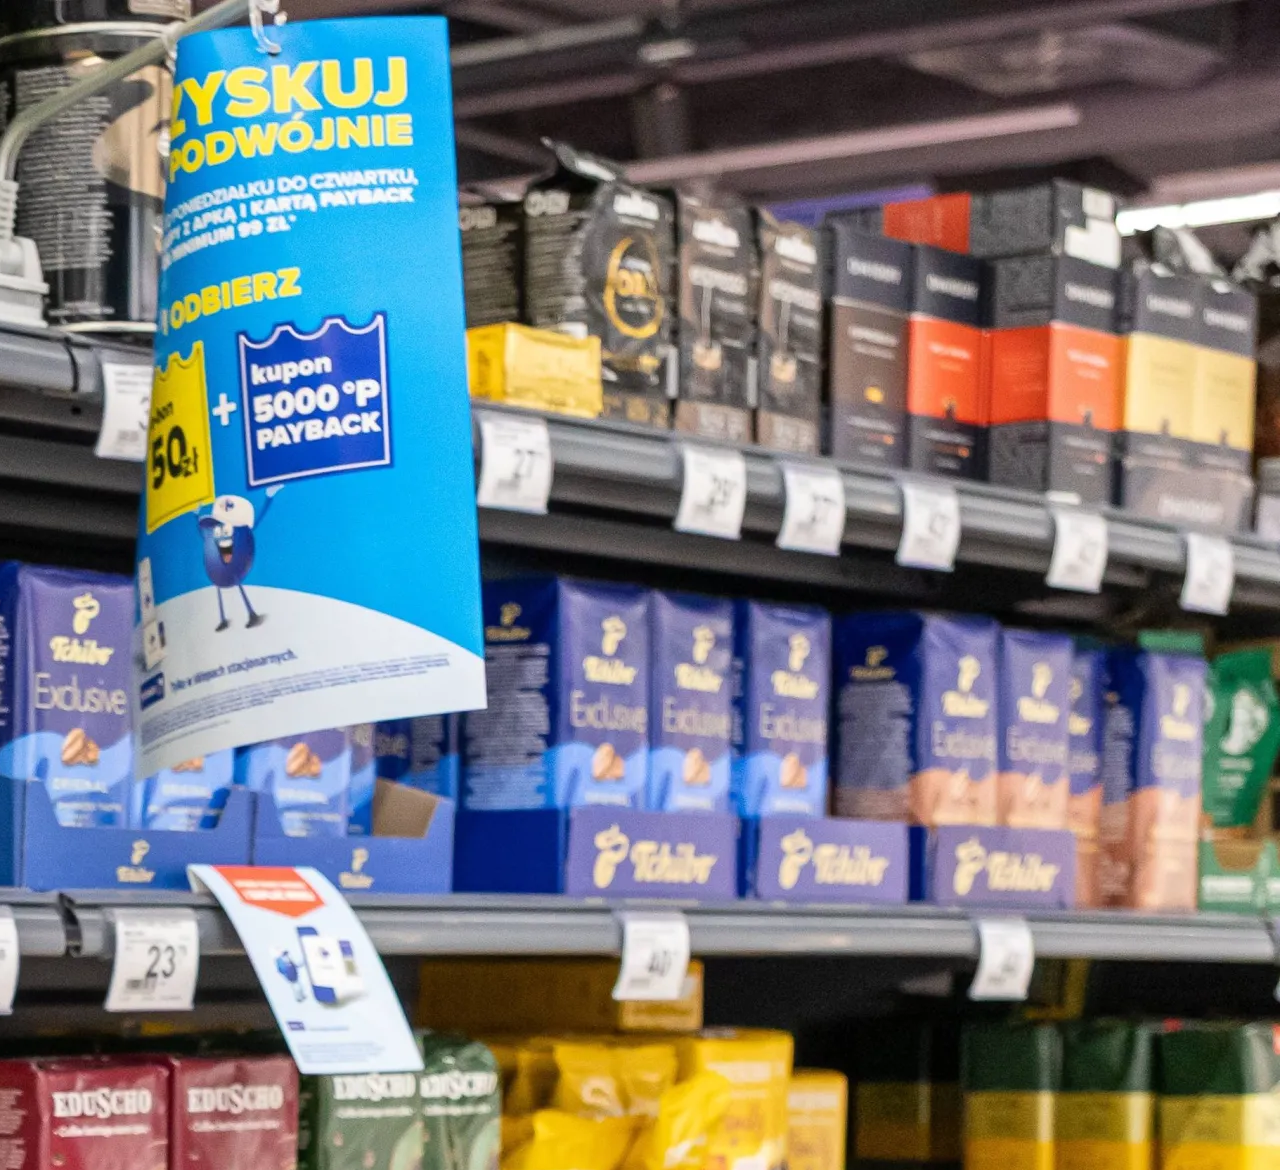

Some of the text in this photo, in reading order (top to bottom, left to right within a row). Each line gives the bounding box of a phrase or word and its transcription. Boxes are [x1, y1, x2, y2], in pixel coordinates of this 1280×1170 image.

[170, 112, 414, 183] PODWÓJNIE
[277, 175, 307, 194] DO
[240, 202, 247, 218] I
[250, 193, 318, 216] KARTĄ
[320, 186, 416, 208] PAYBACK
[237, 218, 263, 239] 99
[170, 266, 303, 330] ODBIERZ
[250, 356, 333, 386] kupon
[252, 383, 339, 424] 5000
[255, 411, 383, 451] PAYBACK
[151, 425, 187, 490] 50
[50, 636, 114, 667] Tchibo
[34, 673, 128, 716] Exclusive
[145, 945, 176, 979] 23
[52, 1087, 152, 1118] EDUSCHO
[187, 1083, 284, 1114] EDUSCHO
